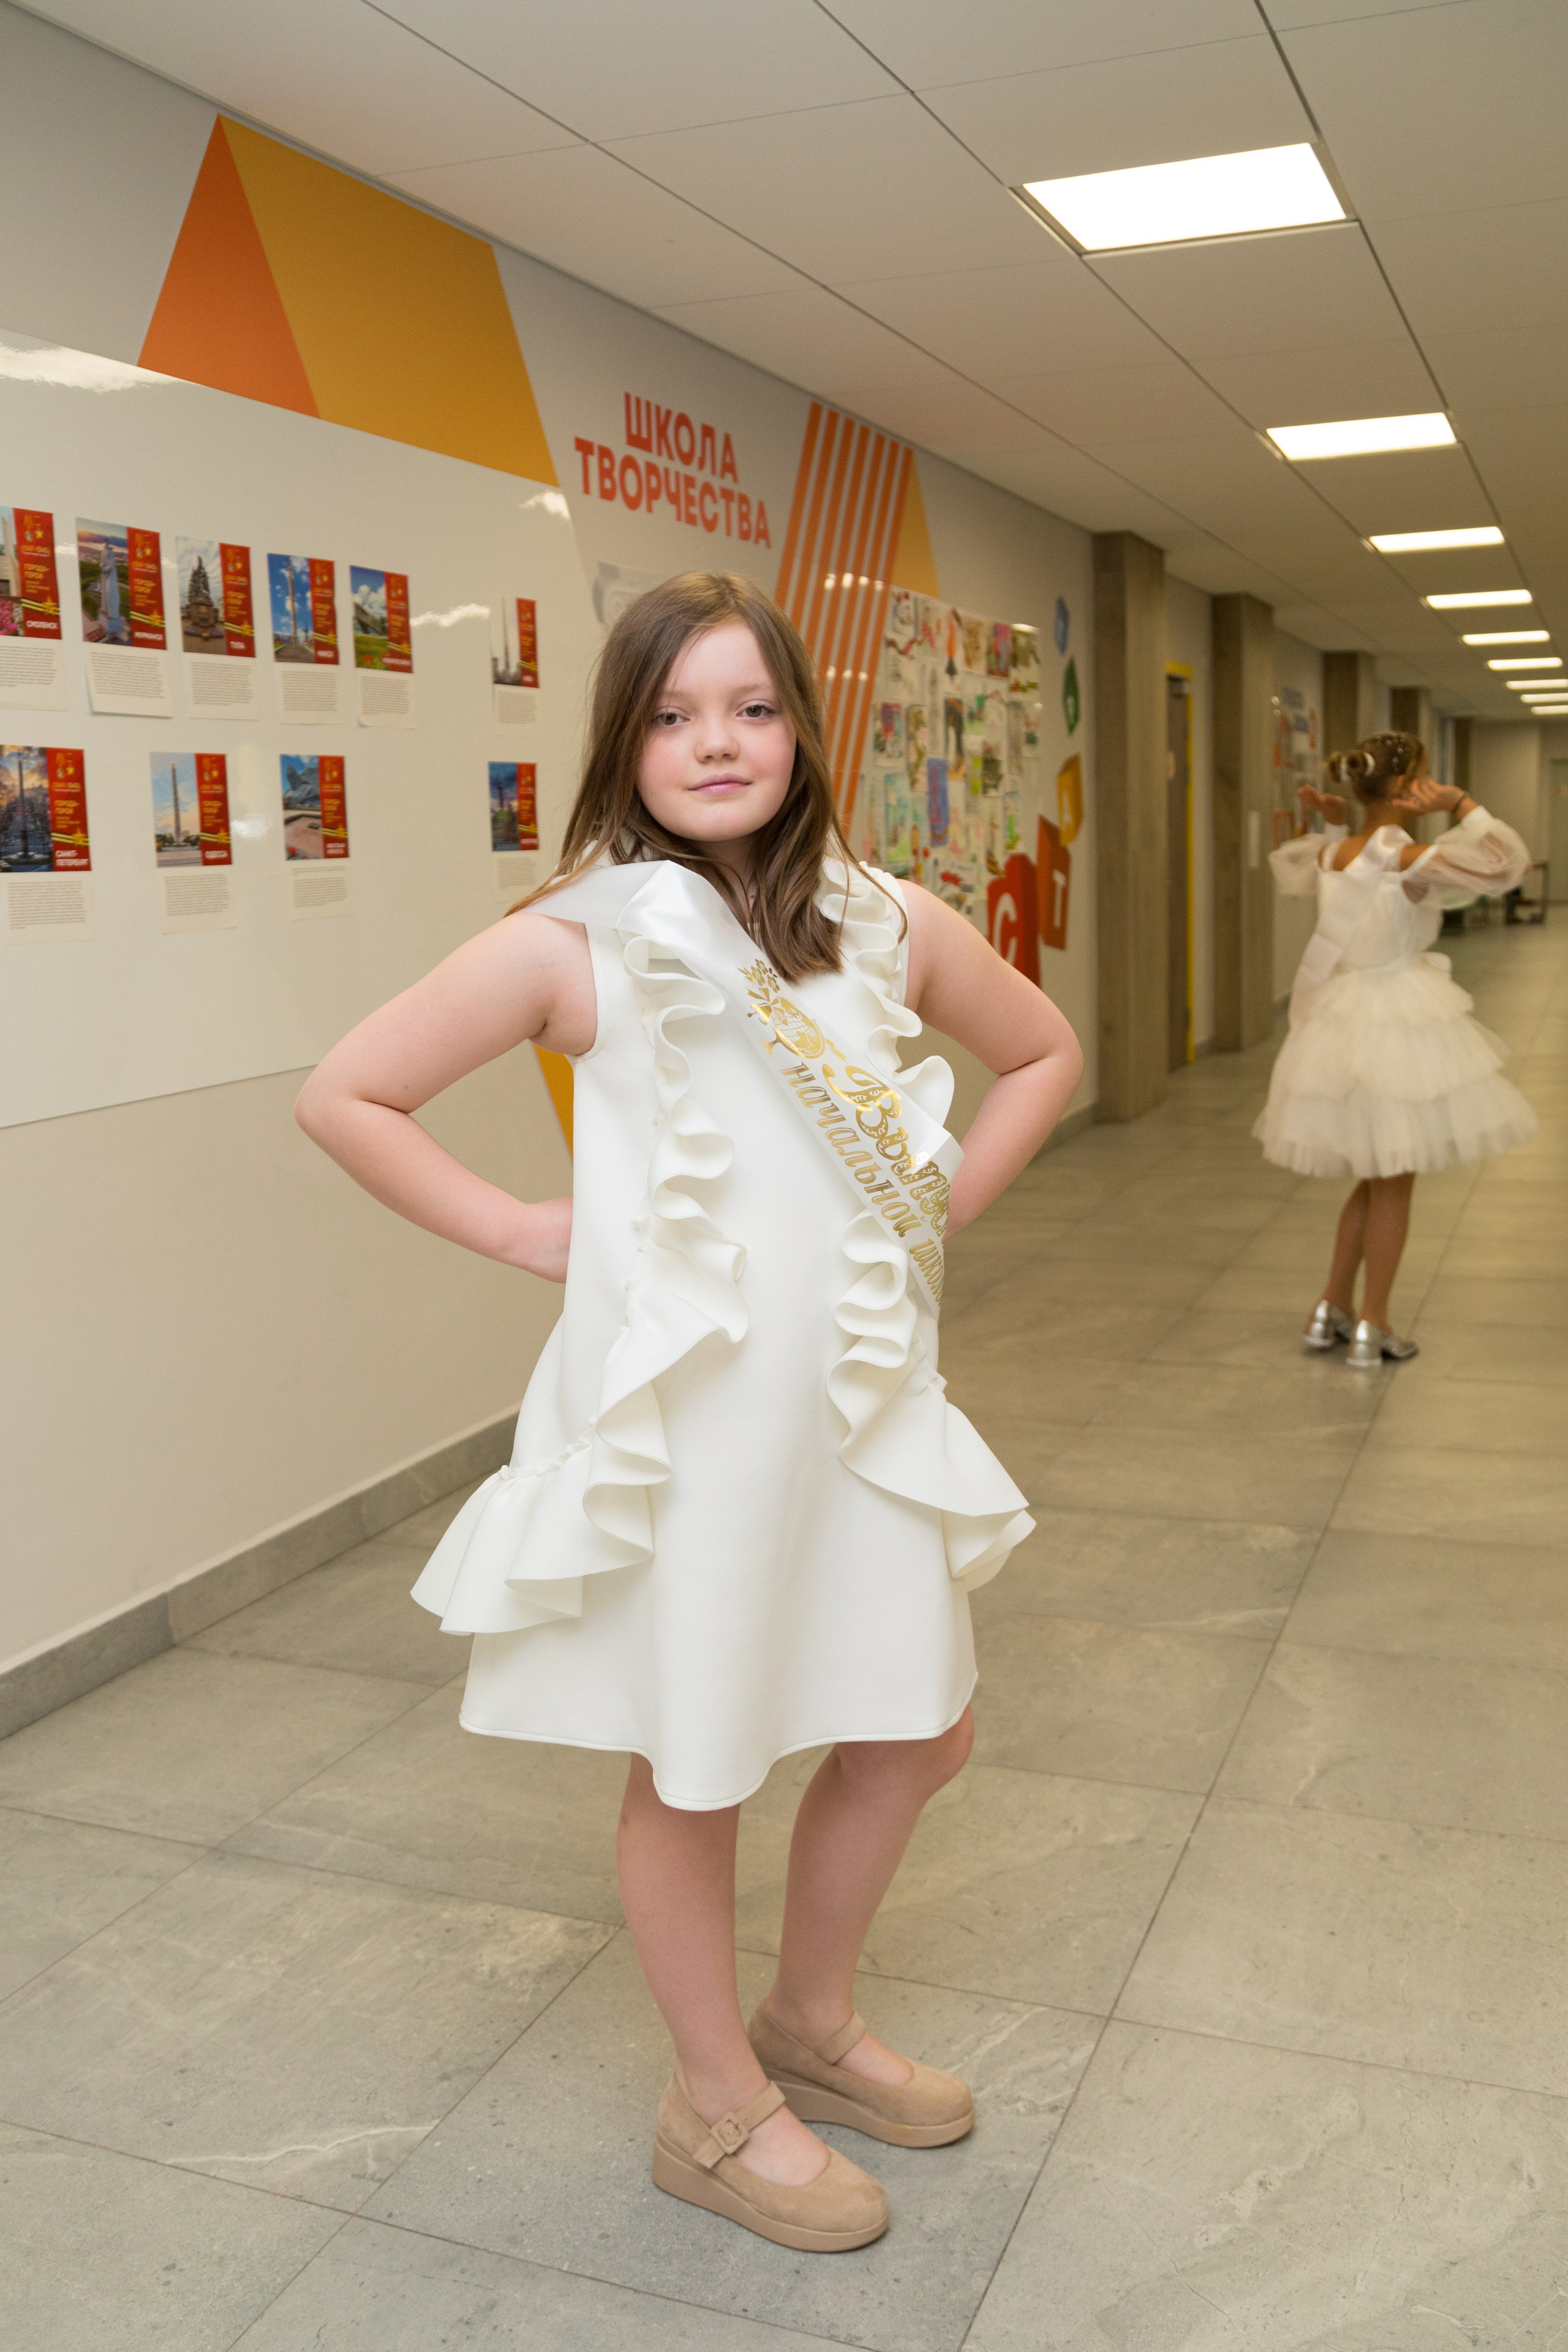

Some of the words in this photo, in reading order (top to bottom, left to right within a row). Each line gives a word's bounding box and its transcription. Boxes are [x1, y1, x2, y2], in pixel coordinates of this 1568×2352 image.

[574, 435, 772, 549] ТВОРЧЕСТВА
[624, 391, 739, 483] ШКОЛА
[780, 1061, 927, 1238] начальной
